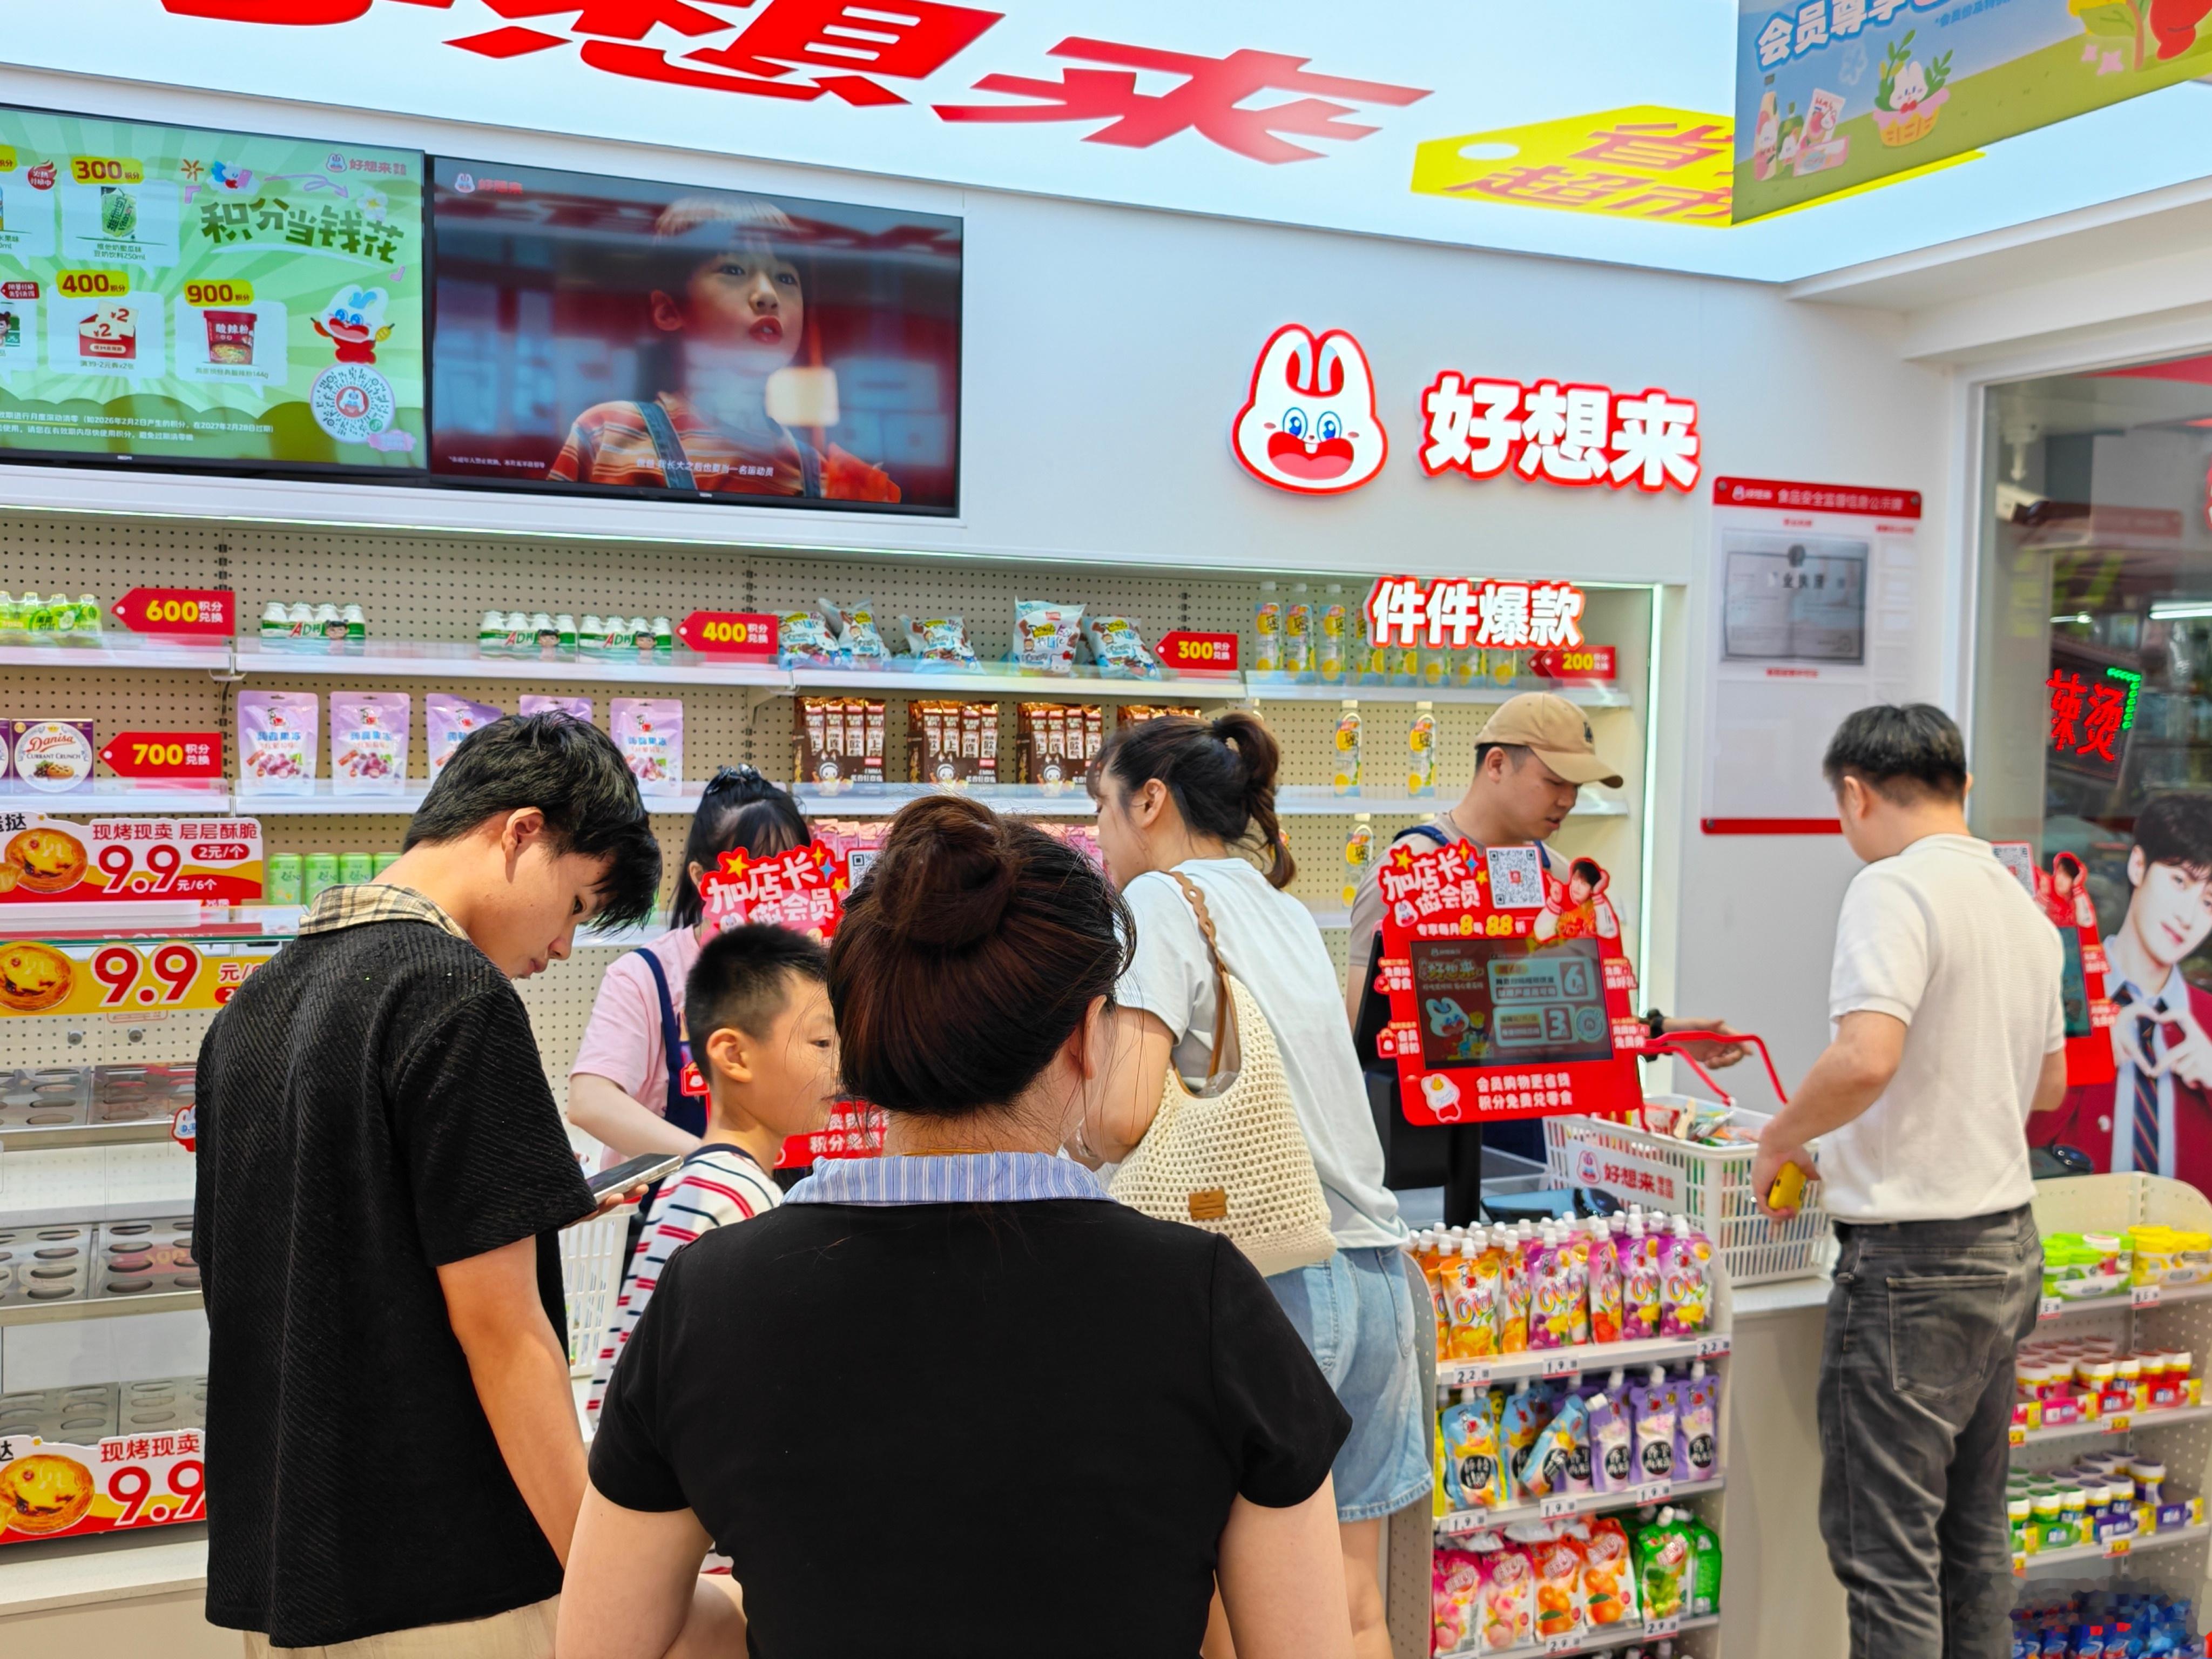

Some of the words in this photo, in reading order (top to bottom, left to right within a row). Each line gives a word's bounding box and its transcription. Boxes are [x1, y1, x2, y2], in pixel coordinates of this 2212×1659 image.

[75, 161, 123, 179] 300
[349, 158, 391, 174] 好想来
[200, 197, 405, 264] 积分当钱花
[62, 274, 109, 293] 400
[187, 285, 233, 303] 900
[1426, 373, 1699, 490] 好想来
[146, 600, 198, 622] 600
[199, 601, 222, 611] 积分
[1371, 581, 1581, 648] 件件爆款
[198, 612, 224, 623] 兑换
[703, 622, 746, 643] 400
[747, 623, 767, 633] 积分
[747, 634, 768, 644] 兑换
[1213, 642, 1231, 651] 积分
[1177, 640, 1213, 659] 300
[1562, 653, 1594, 670] 200
[24, 732, 76, 752] Danisa
[185, 743, 211, 754] 积分
[133, 743, 185, 766] 700
[185, 754, 211, 766] 兑换
[92, 824, 174, 841] 现烤现卖
[179, 823, 258, 840] 层层酥脆
[199, 846, 244, 859] 2元/个
[98, 844, 182, 894] 9.9
[1382, 848, 1466, 901] 加店长
[177, 879, 217, 892] 元/6个
[707, 851, 819, 914] 加店长
[748, 887, 834, 925] 做会员
[1415, 879, 1481, 917] 做会员
[92, 944, 203, 1008] 9.9
[1476, 1072, 1572, 1094] 会员购物更省钱
[1478, 1089, 1573, 1111] 积分免费兑零食
[1603, 1161, 1656, 1195] 好想来
[1458, 1369, 1476, 1382] 2.2
[1546, 1360, 1565, 1373] 1.9
[100, 1433, 201, 1463] 现烤现卖
[108, 1459, 205, 1527] 9.9
[1544, 1505, 1562, 1517] 1.9
[1452, 1516, 1471, 1530] 1.9
